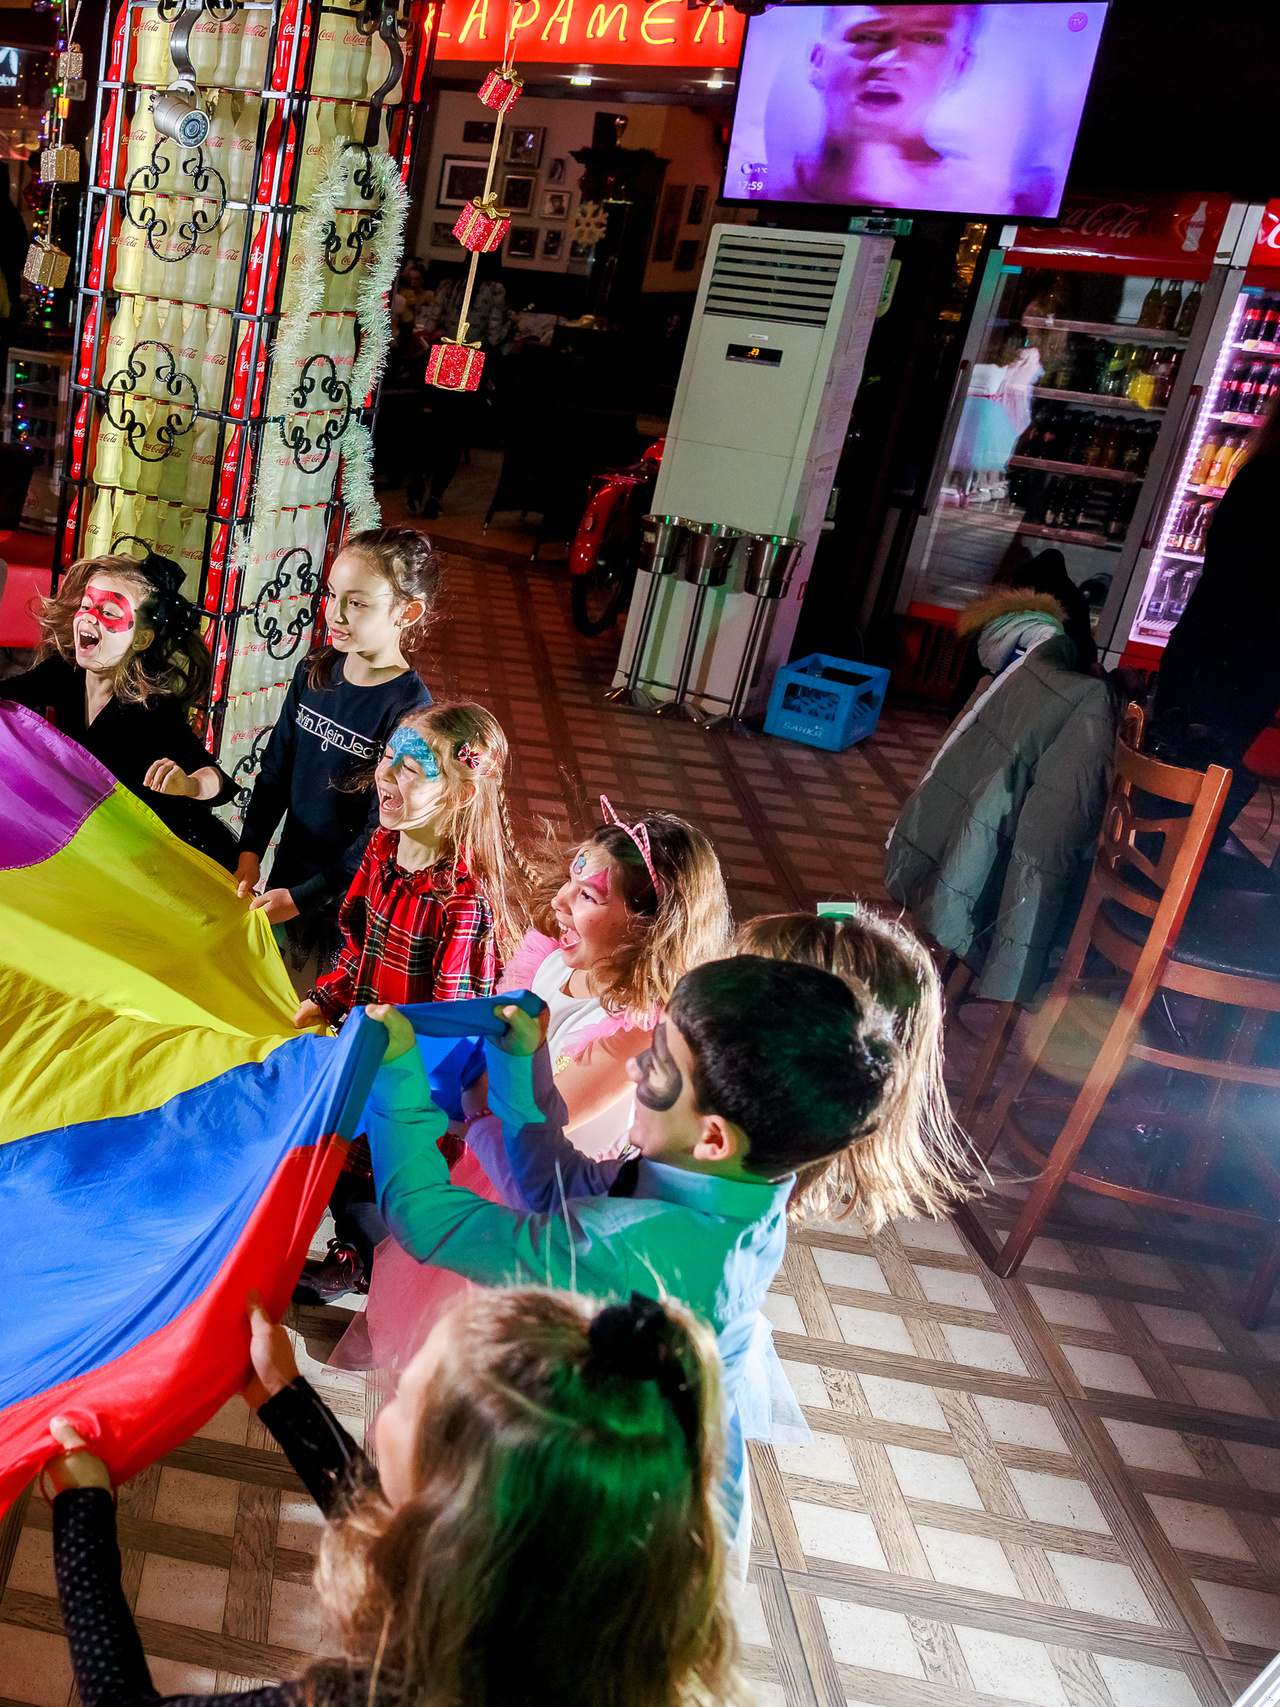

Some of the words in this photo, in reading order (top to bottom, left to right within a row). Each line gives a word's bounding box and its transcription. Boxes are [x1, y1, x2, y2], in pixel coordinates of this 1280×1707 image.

[1072, 18, 1084, 26] TV
[737, 181, 764, 191] 17:59
[315, 717, 345, 744] Klein
